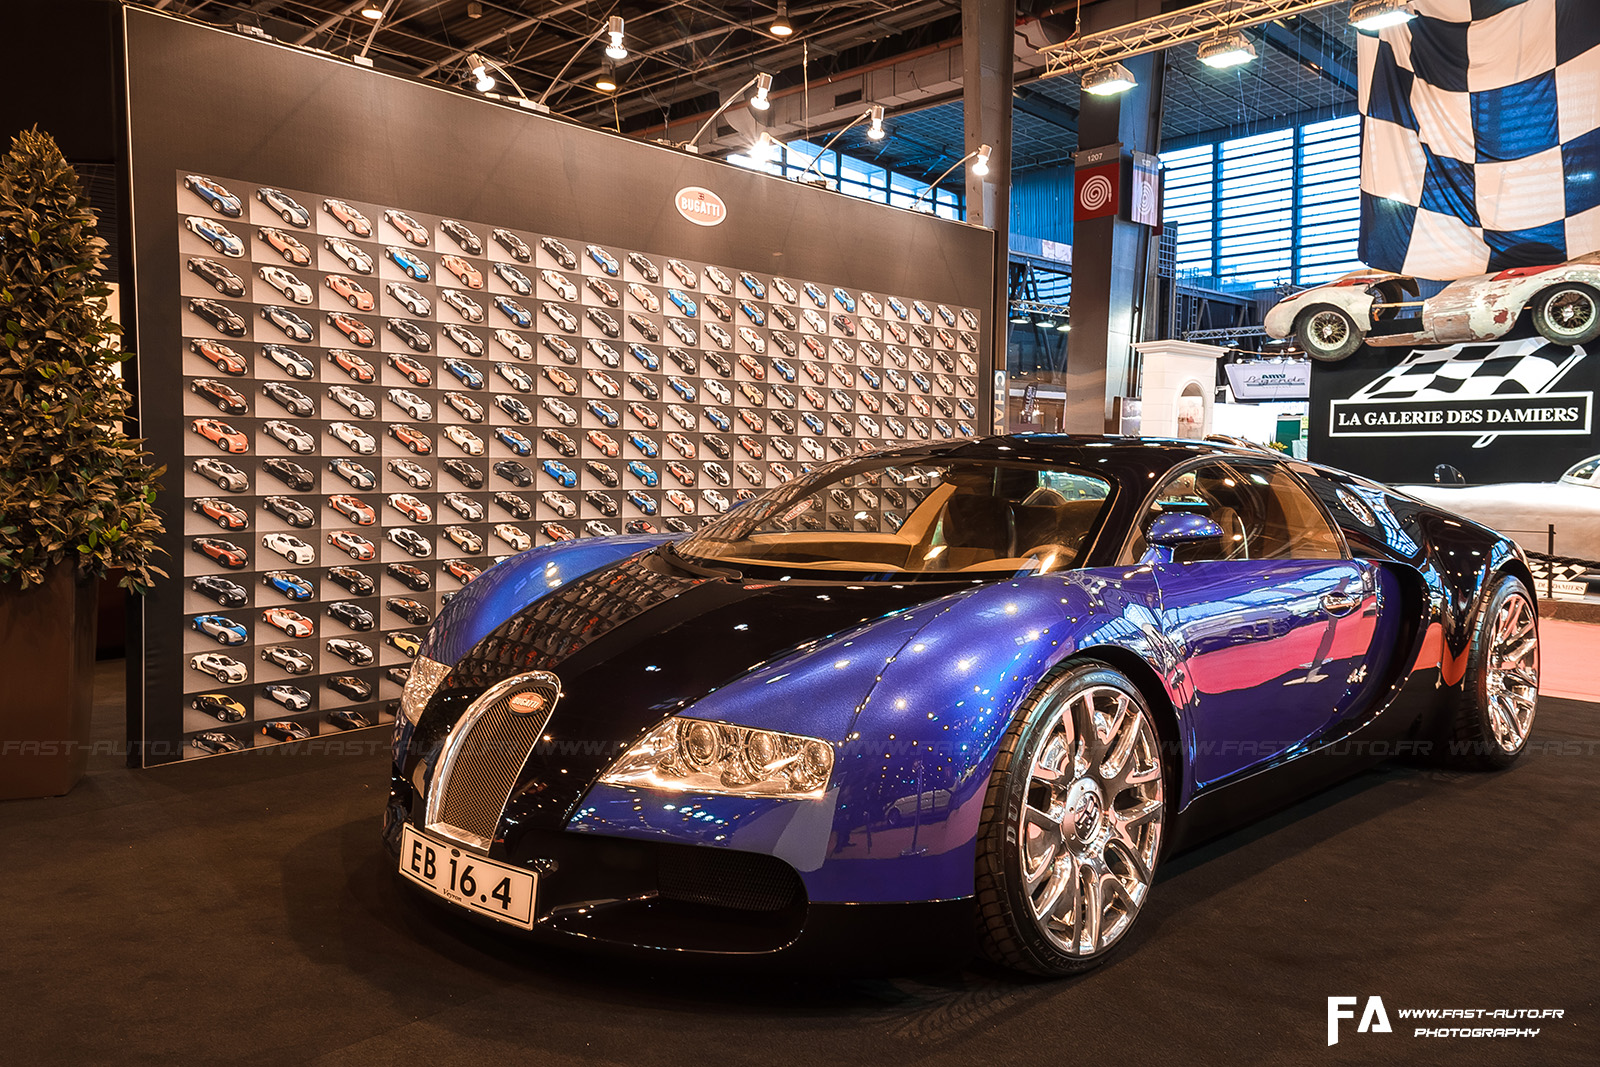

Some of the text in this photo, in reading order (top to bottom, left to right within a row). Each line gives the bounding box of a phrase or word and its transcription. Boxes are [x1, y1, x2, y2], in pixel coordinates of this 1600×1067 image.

[1087, 153, 1103, 162] 1207
[681, 197, 720, 217] BUGATTI
[1338, 407, 1579, 426] LA GALERIE DES DAMIERS
[411, 839, 512, 911] EB 16.4
[442, 888, 462, 902] Veyron
